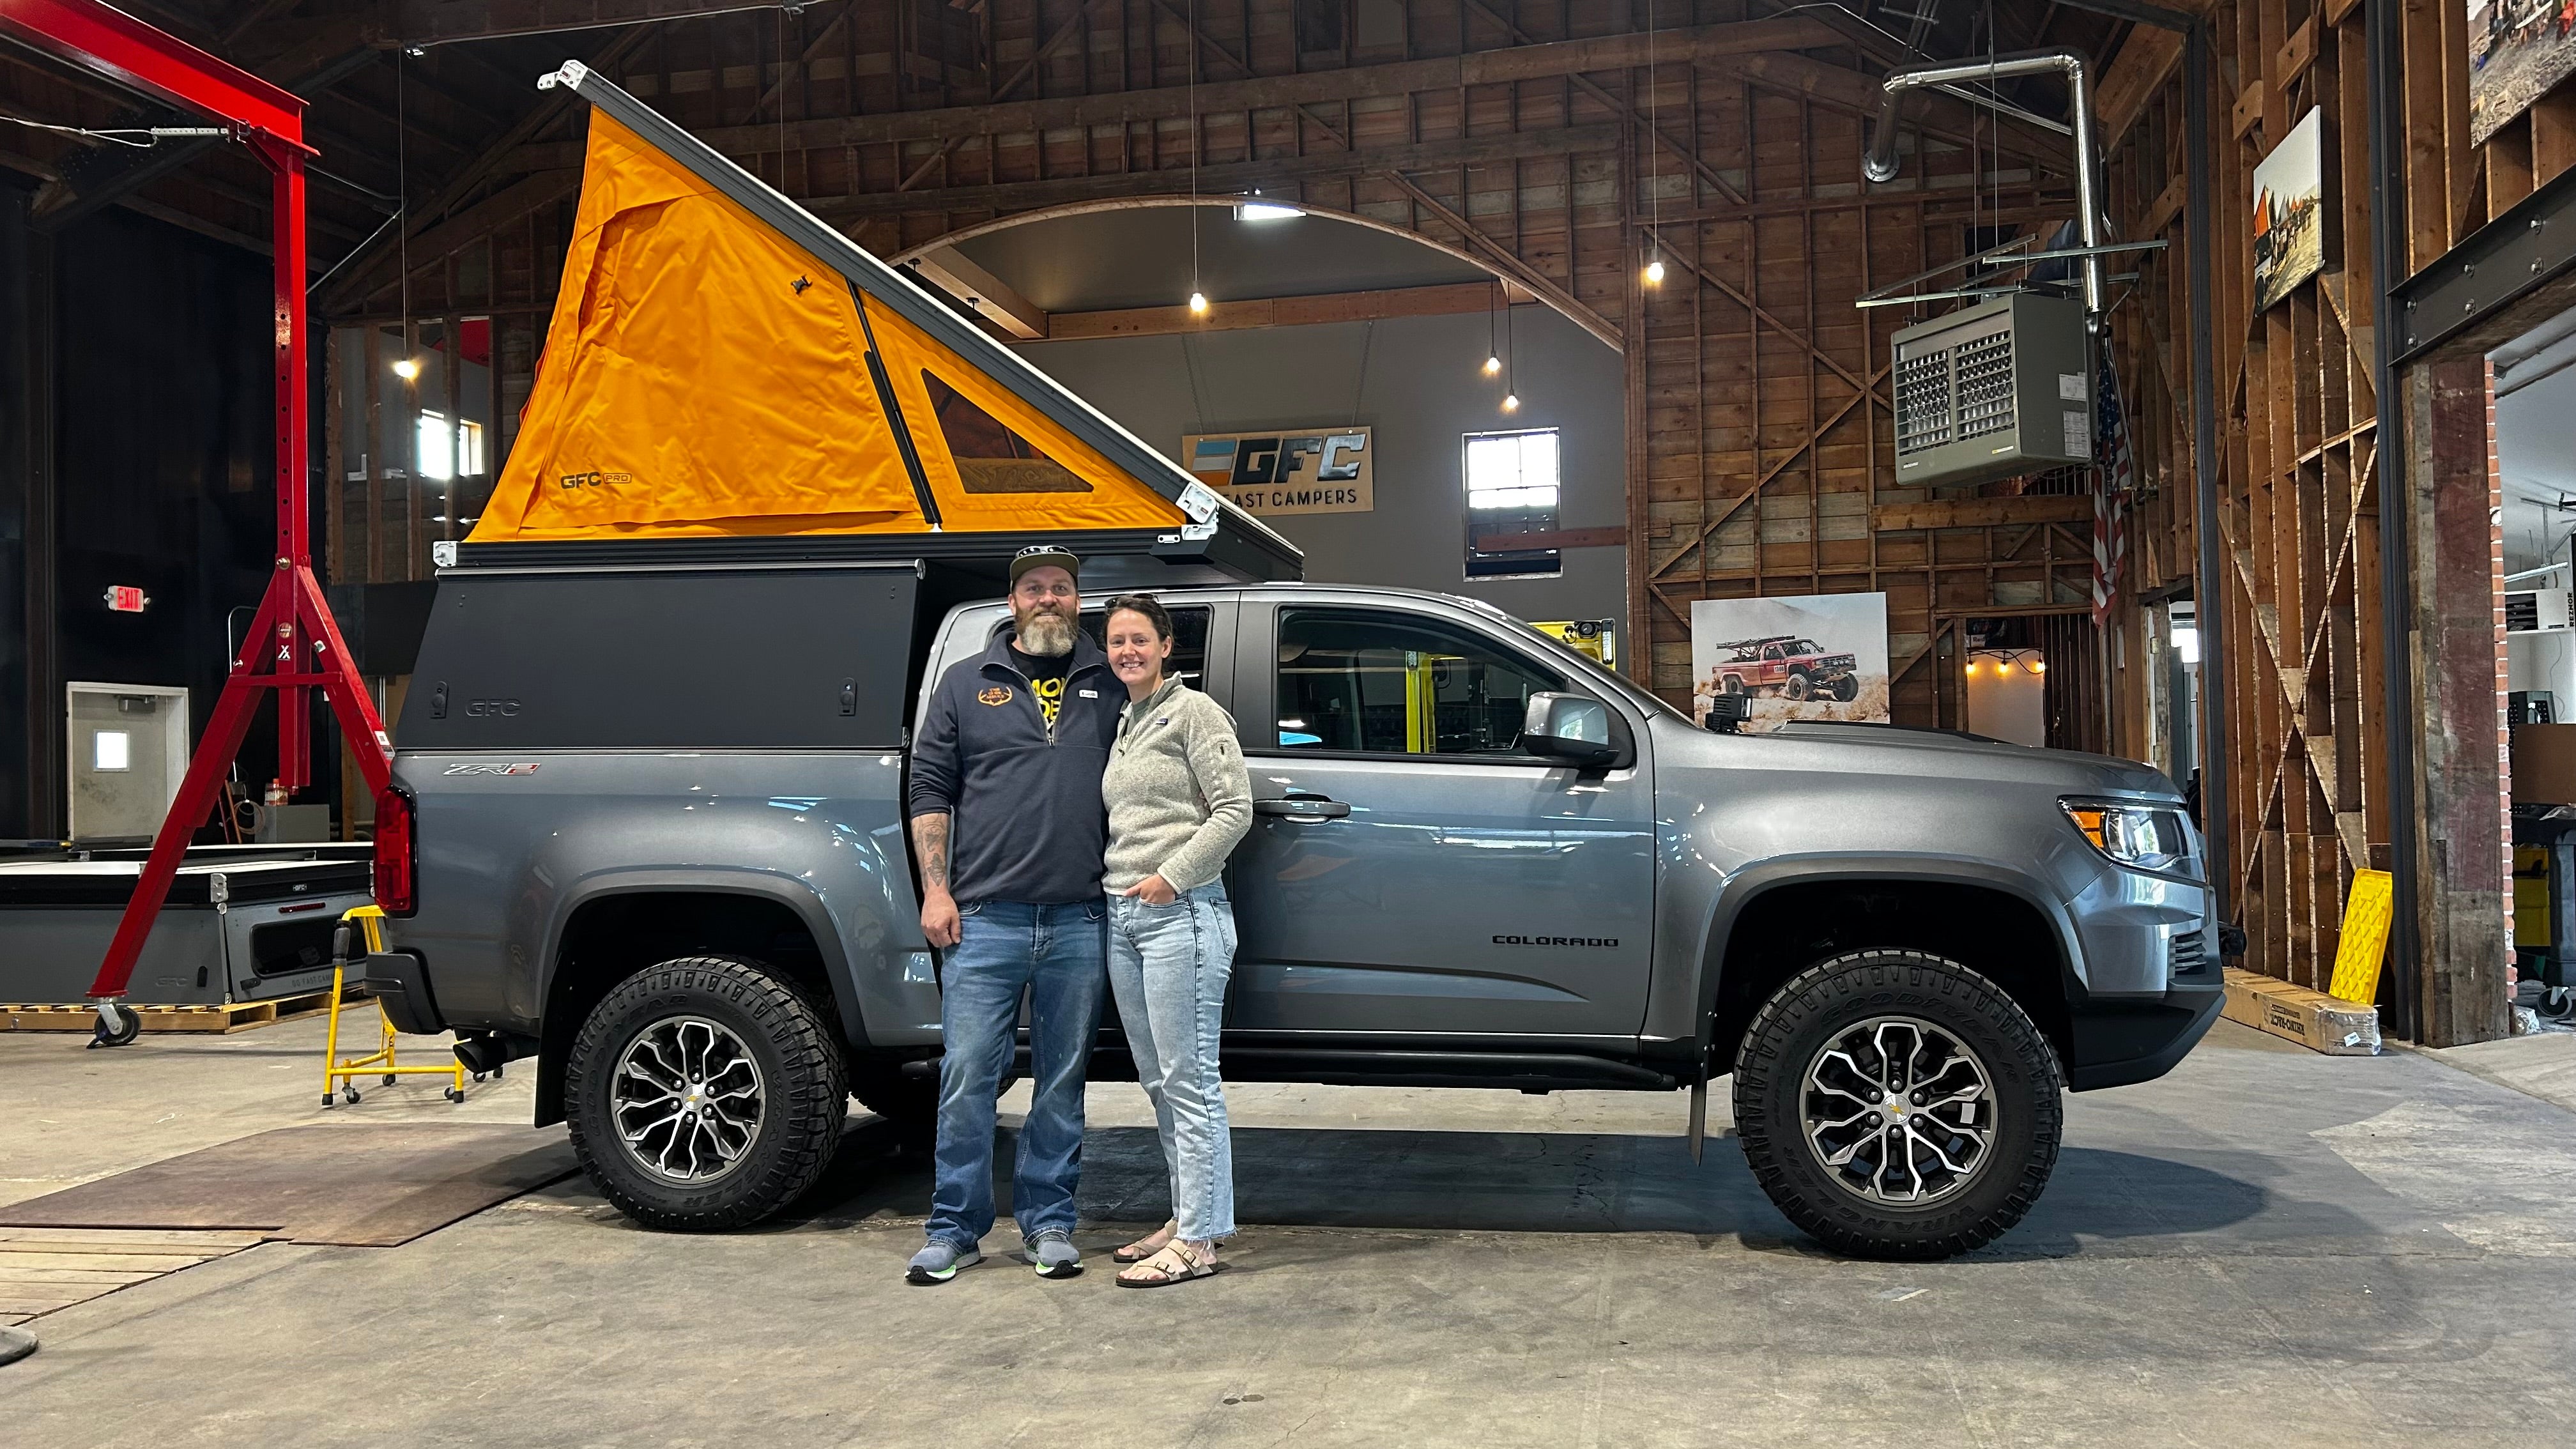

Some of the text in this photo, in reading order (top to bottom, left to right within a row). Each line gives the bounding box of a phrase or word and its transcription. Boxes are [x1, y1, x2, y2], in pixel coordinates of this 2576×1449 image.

[1232, 433, 1367, 486] GFC
[560, 471, 601, 489] GFC
[1272, 488, 1357, 507] CAMPERS
[118, 587, 140, 610] EXIT
[465, 698, 521, 717] GFC
[443, 763, 541, 776] ZR2
[1492, 935, 1619, 947] COLORADO
